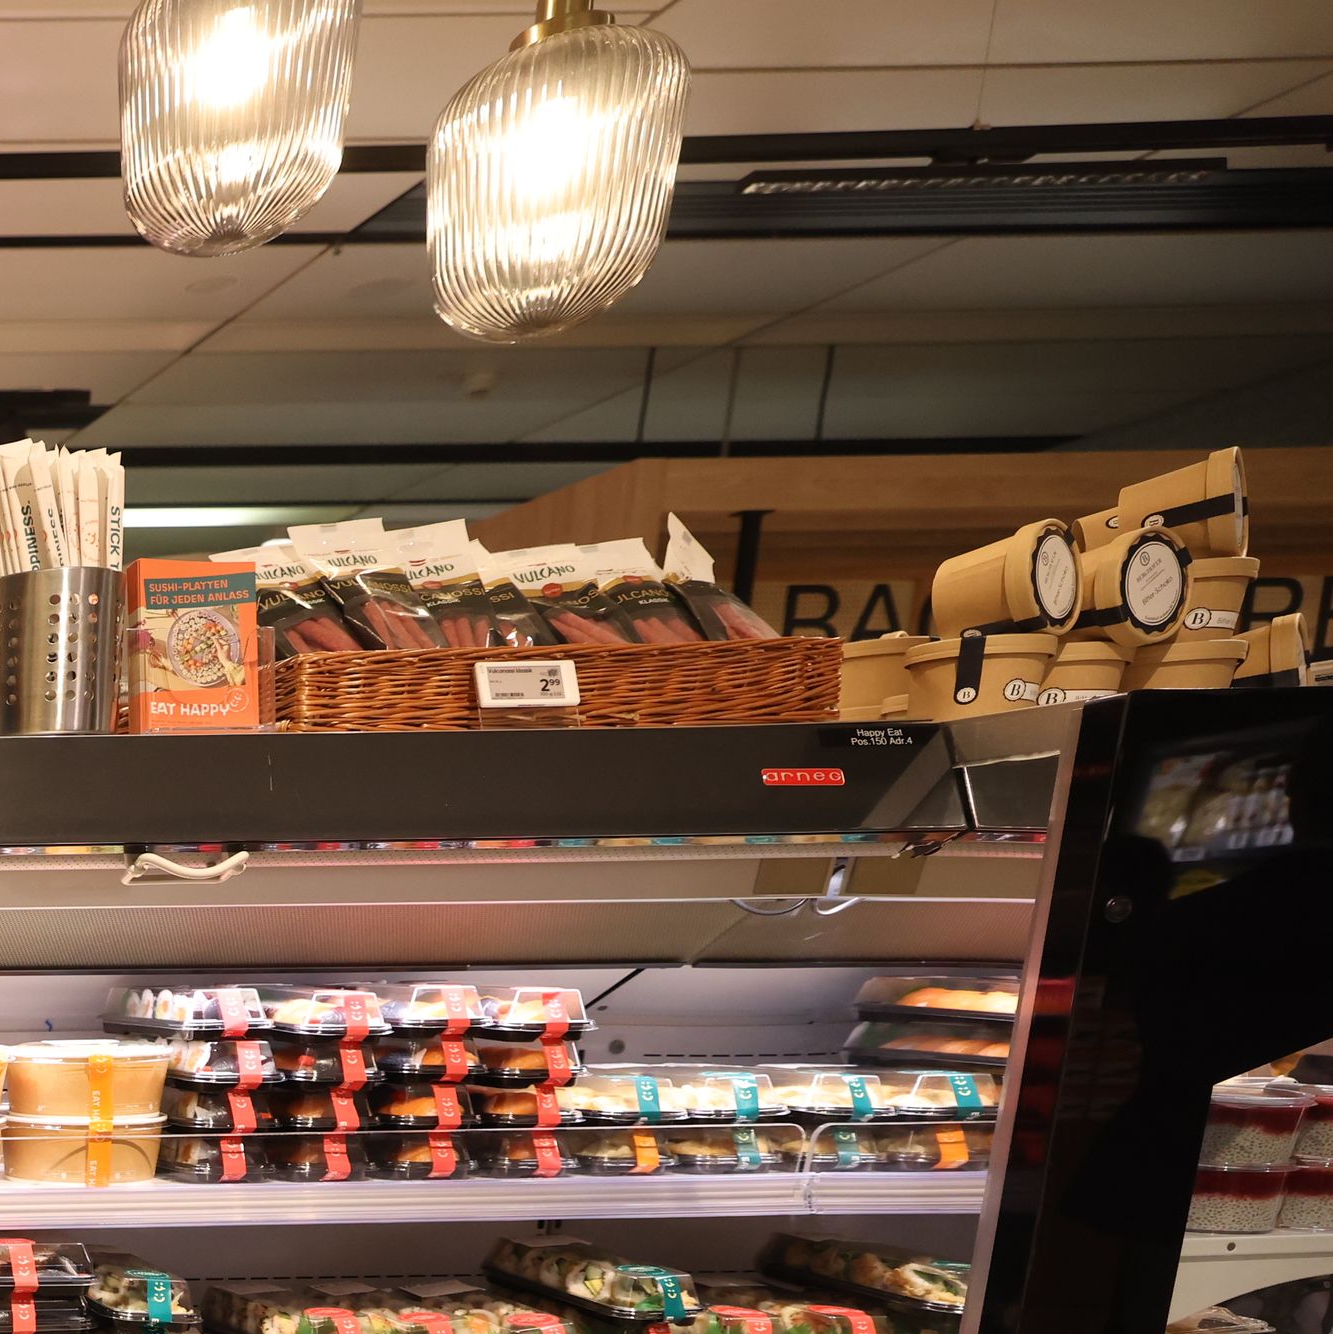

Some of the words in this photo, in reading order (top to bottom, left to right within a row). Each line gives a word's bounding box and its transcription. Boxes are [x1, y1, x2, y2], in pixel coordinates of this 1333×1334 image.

[110, 505, 121, 555] STICK
[513, 564, 575, 584] VULCANO
[149, 579, 228, 592] SUSHI-PLATTEN
[150, 594, 169, 606] FÜR
[171, 594, 204, 604] JEDEN
[207, 590, 249, 602] ANLASS
[1192, 612, 1204, 625] B
[1009, 683, 1020, 696] B
[150, 701, 176, 716] EAT
[180, 702, 230, 716] HAPPY
[850, 736, 886, 746] Pos.150
[889, 736, 913, 745] Adr.4
[856, 729, 884, 740] Happy
[887, 727, 903, 736] Eat
[92, 1090, 101, 1107] EAT
[89, 1160, 98, 1176] EAT
